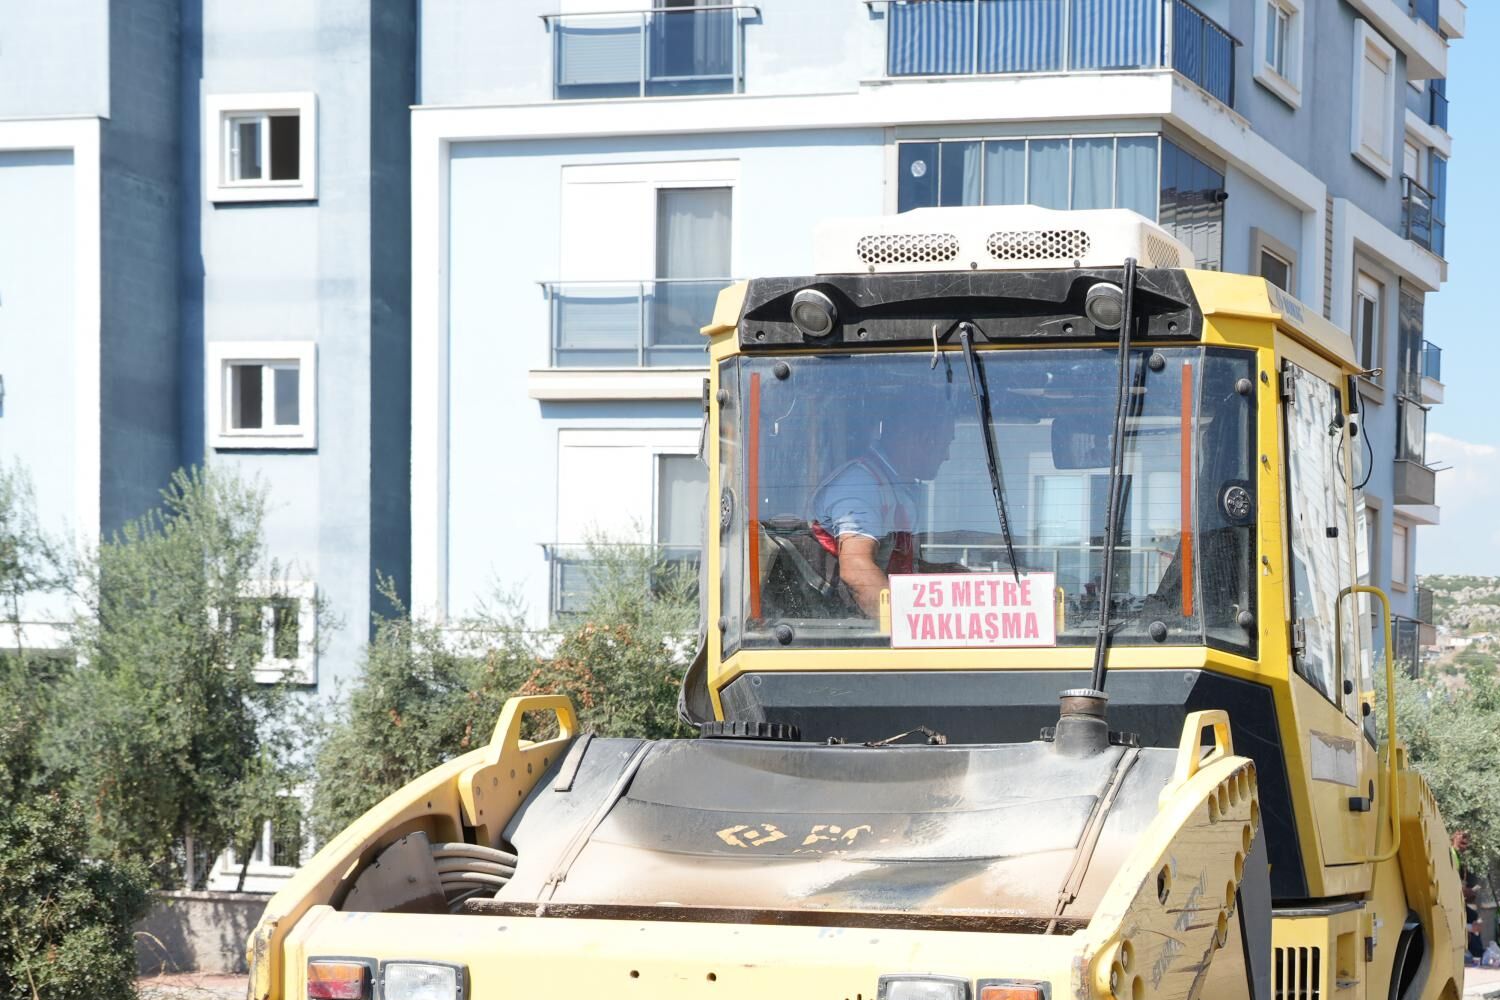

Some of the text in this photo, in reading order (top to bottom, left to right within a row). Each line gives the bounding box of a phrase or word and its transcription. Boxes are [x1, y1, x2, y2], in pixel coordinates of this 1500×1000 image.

[912, 579, 1032, 607] 25 METRE
[906, 612, 1040, 643] YAKLAŞMA
